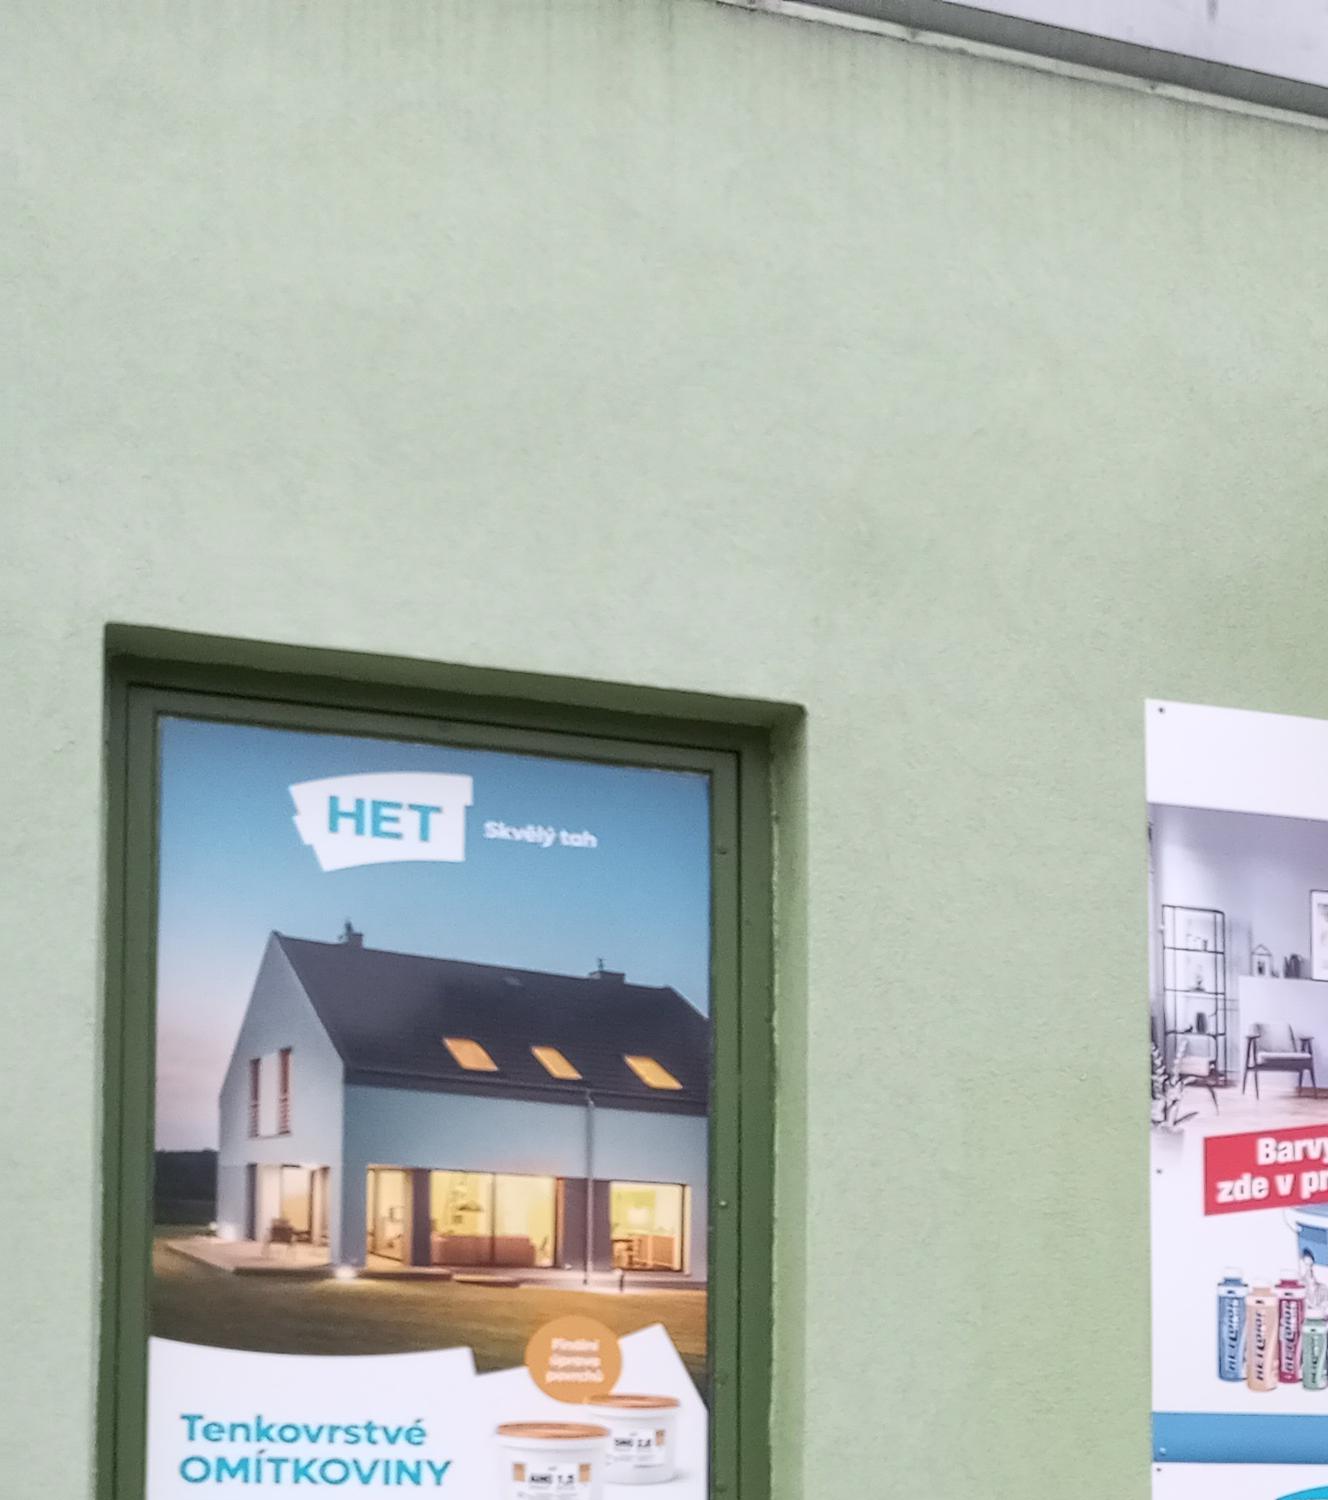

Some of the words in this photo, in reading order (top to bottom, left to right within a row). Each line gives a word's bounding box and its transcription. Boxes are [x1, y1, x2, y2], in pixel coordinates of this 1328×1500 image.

[328, 795, 443, 842] HET
[483, 820, 555, 848] Skvělý
[560, 829, 598, 848] tah
[1216, 1172, 1270, 1203] zde
[1275, 1173, 1294, 1196] v
[180, 1413, 427, 1446] Tenkovrstvé
[179, 1449, 451, 1486] OMÍTKOVINY
